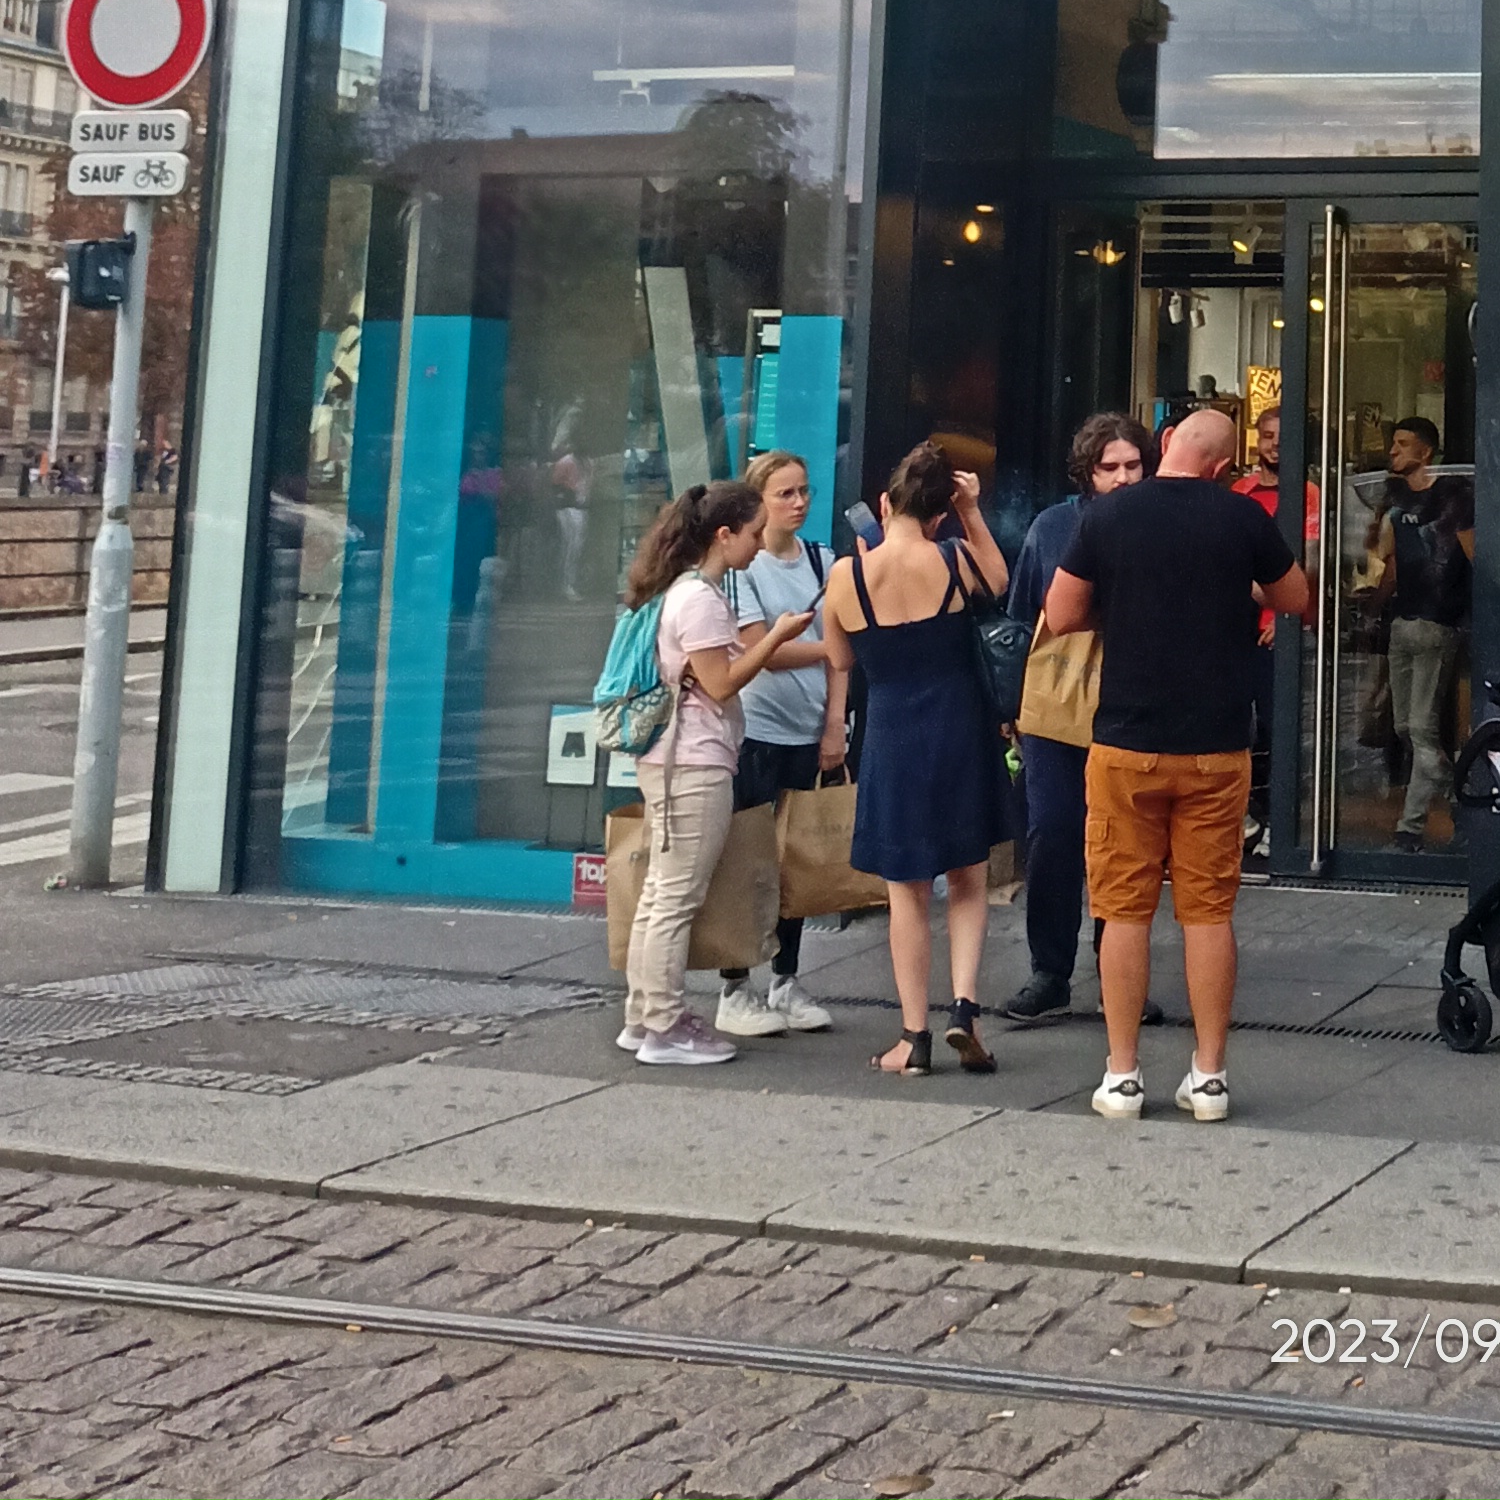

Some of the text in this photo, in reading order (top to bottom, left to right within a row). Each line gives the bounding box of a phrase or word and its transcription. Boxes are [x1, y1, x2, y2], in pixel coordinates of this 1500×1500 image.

[79, 123, 176, 141] SAUF BUS
[79, 165, 126, 183] SAUF
